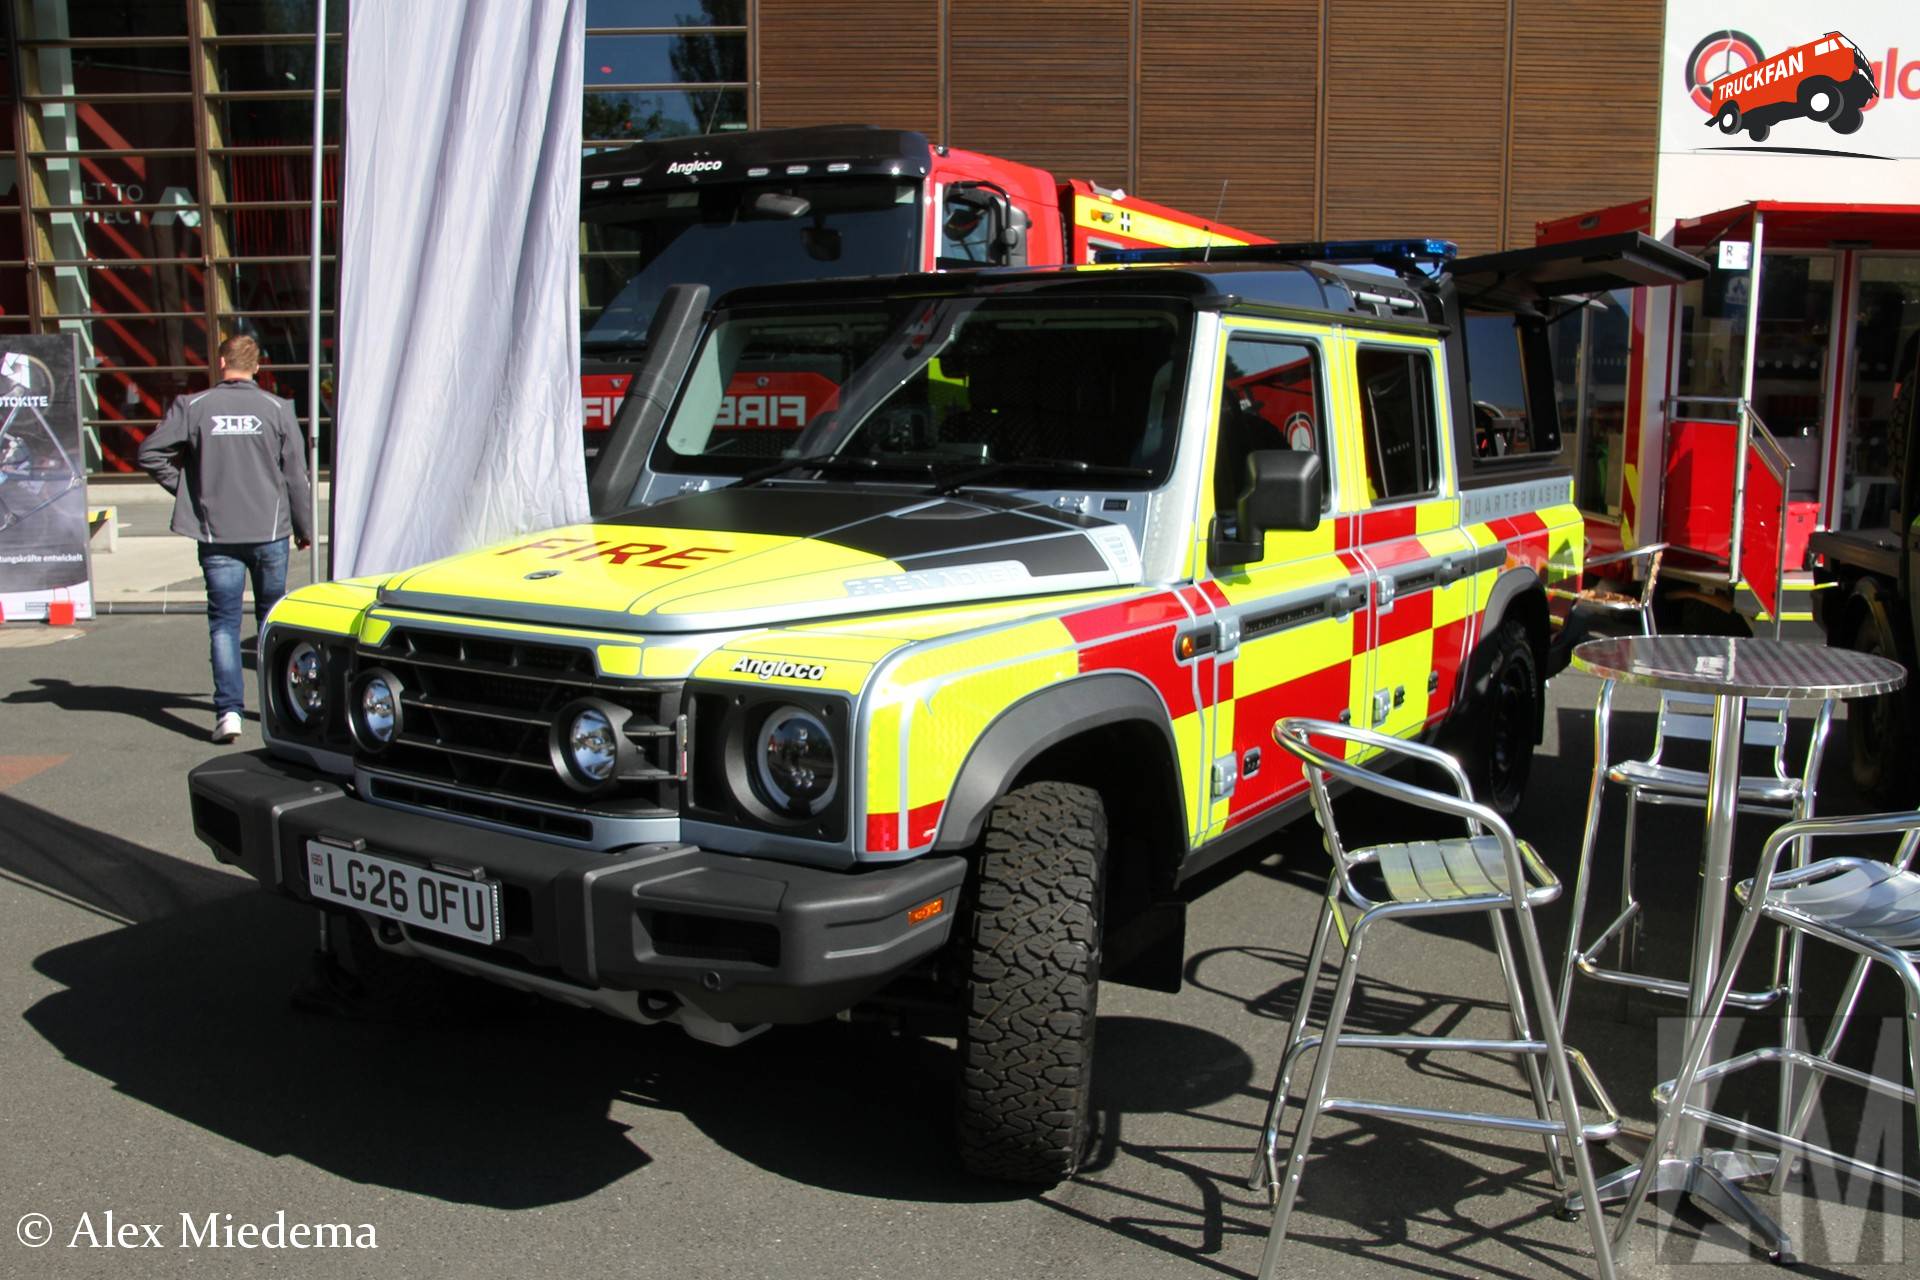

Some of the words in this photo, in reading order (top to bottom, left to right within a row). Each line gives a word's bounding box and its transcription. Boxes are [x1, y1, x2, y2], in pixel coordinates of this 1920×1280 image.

[667, 160, 722, 175] Angloco
[496, 538, 735, 570] FIRE
[730, 656, 826, 680] Angloco
[313, 873, 324, 887] UK
[327, 853, 409, 913] LG26
[418, 877, 485, 932] OFU
